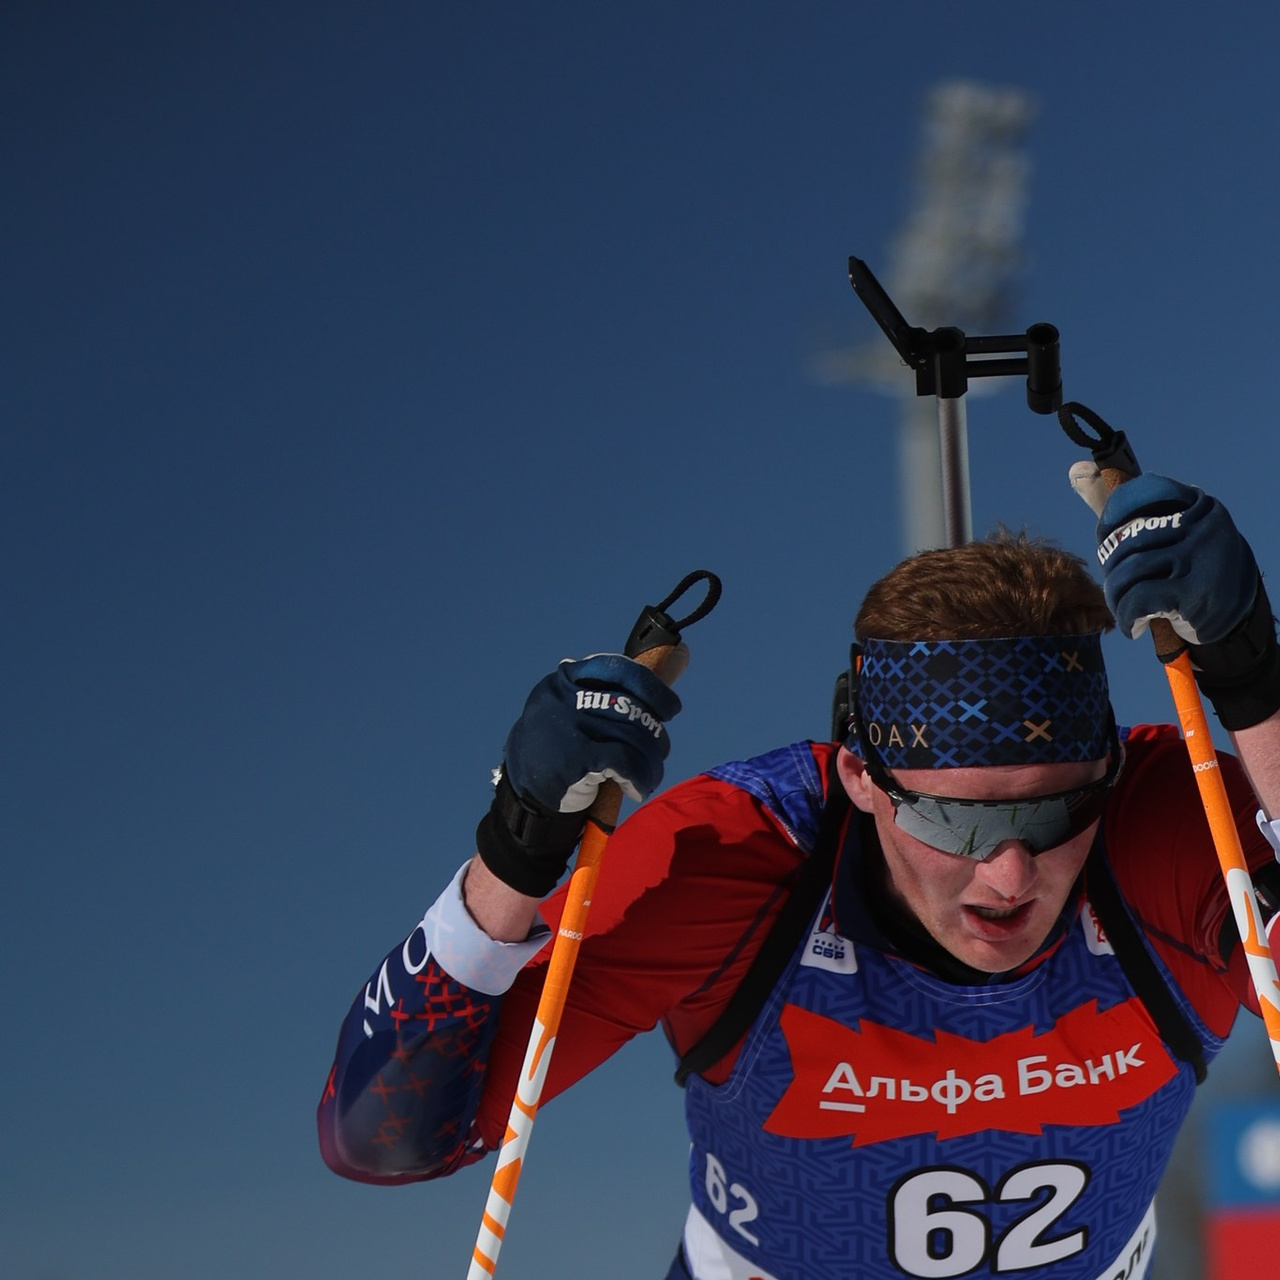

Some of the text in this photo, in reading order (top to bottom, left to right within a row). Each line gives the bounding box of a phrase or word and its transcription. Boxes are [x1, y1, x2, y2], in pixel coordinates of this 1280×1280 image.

[820, 1042, 1146, 1113] Альфа Банк
[705, 1153, 759, 1247] 62
[888, 1160, 1088, 1280] 62
